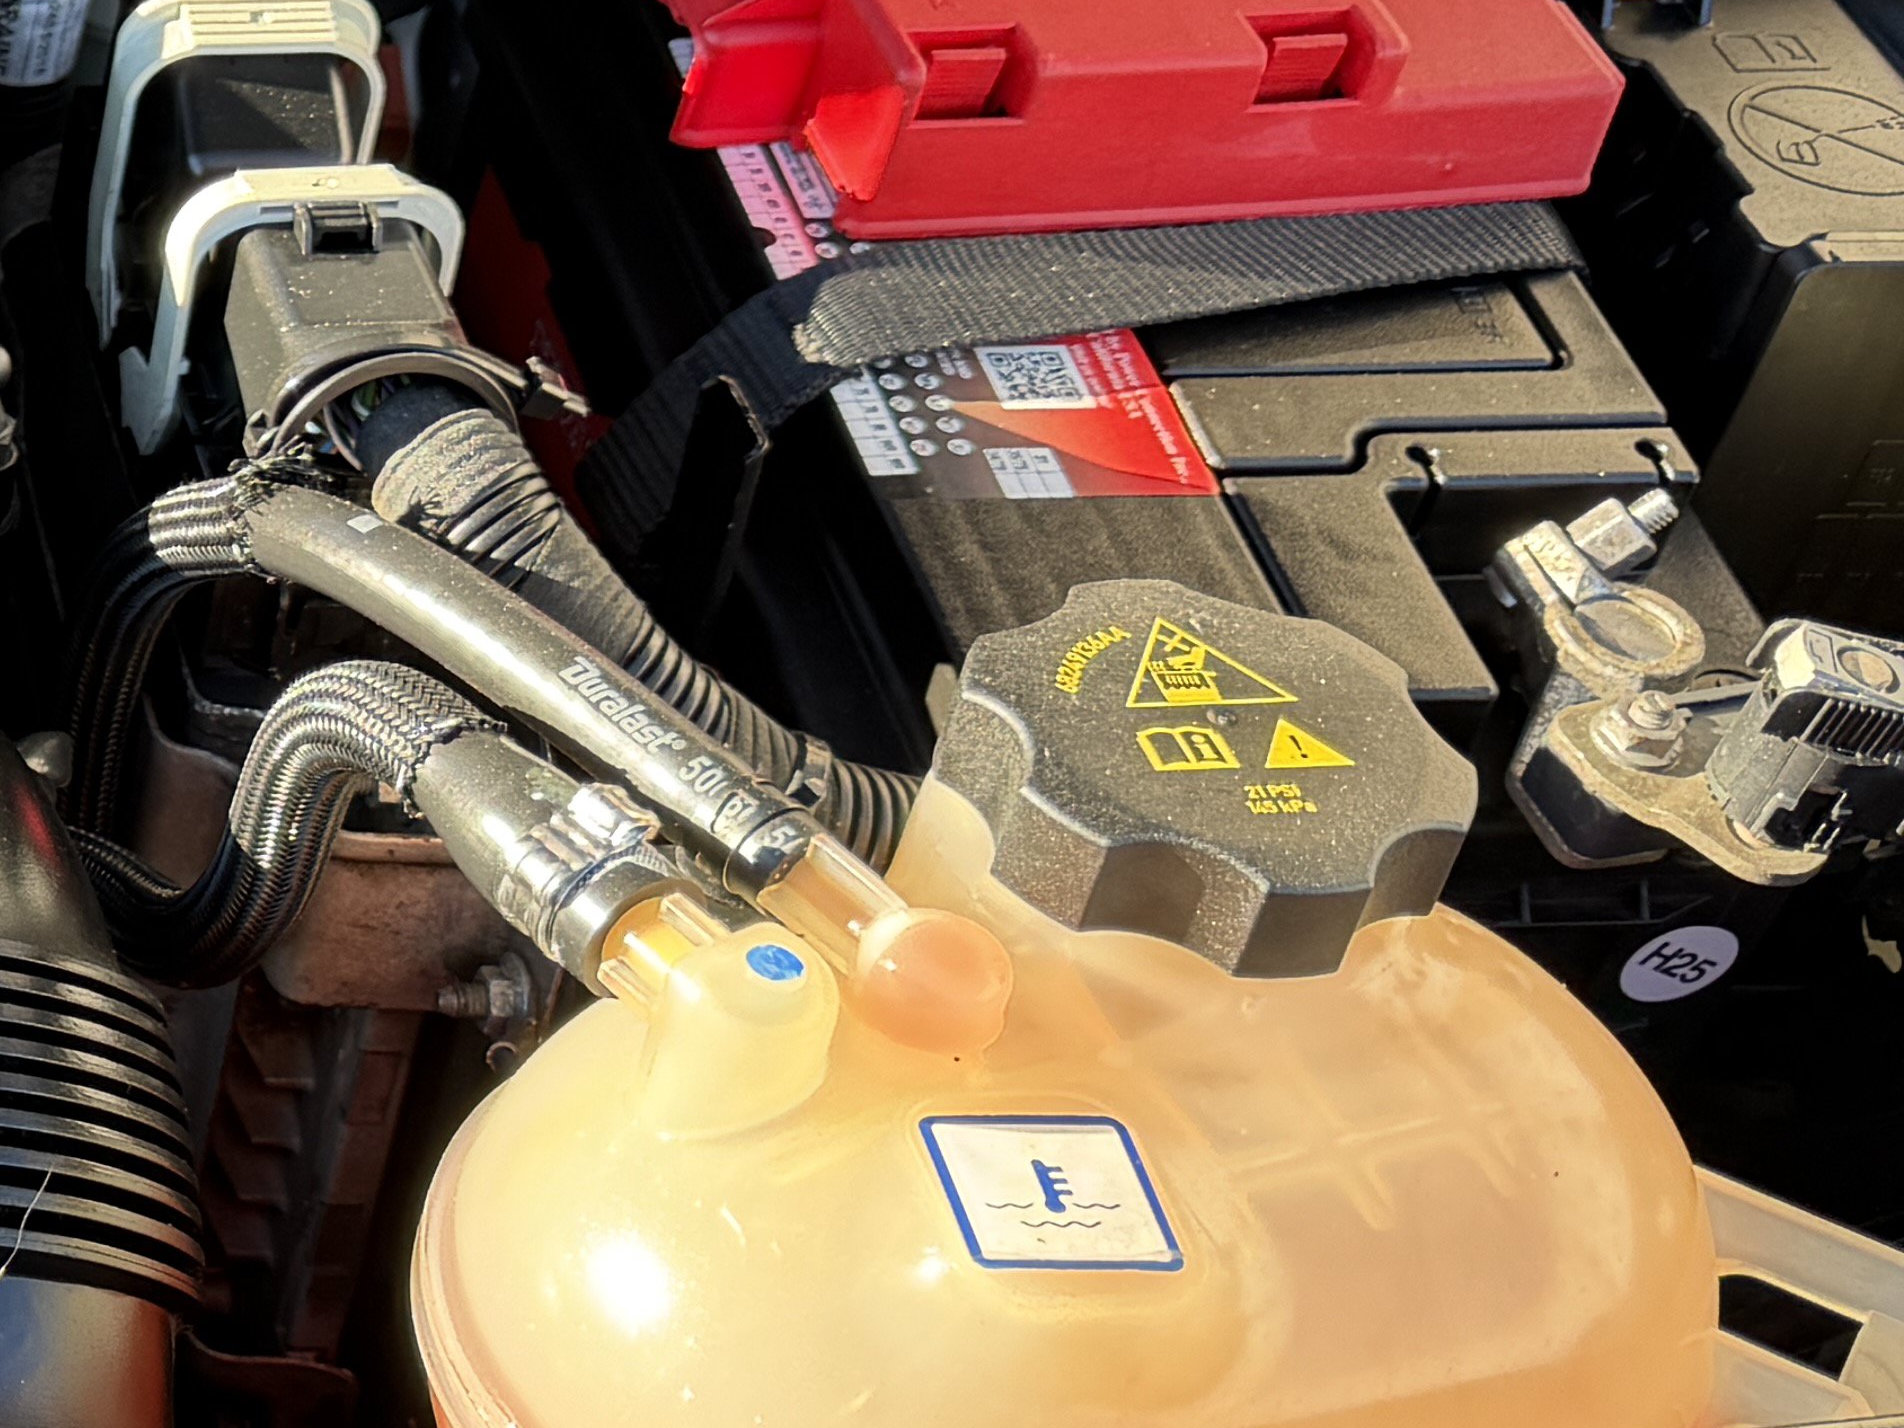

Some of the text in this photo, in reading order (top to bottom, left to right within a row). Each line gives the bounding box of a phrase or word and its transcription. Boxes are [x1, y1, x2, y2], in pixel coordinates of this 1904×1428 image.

[558, 655, 676, 753] Duralast
[1268, 783, 1302, 798] PSI
[1278, 799, 1319, 814] kPa
[1638, 941, 1718, 985] H25
